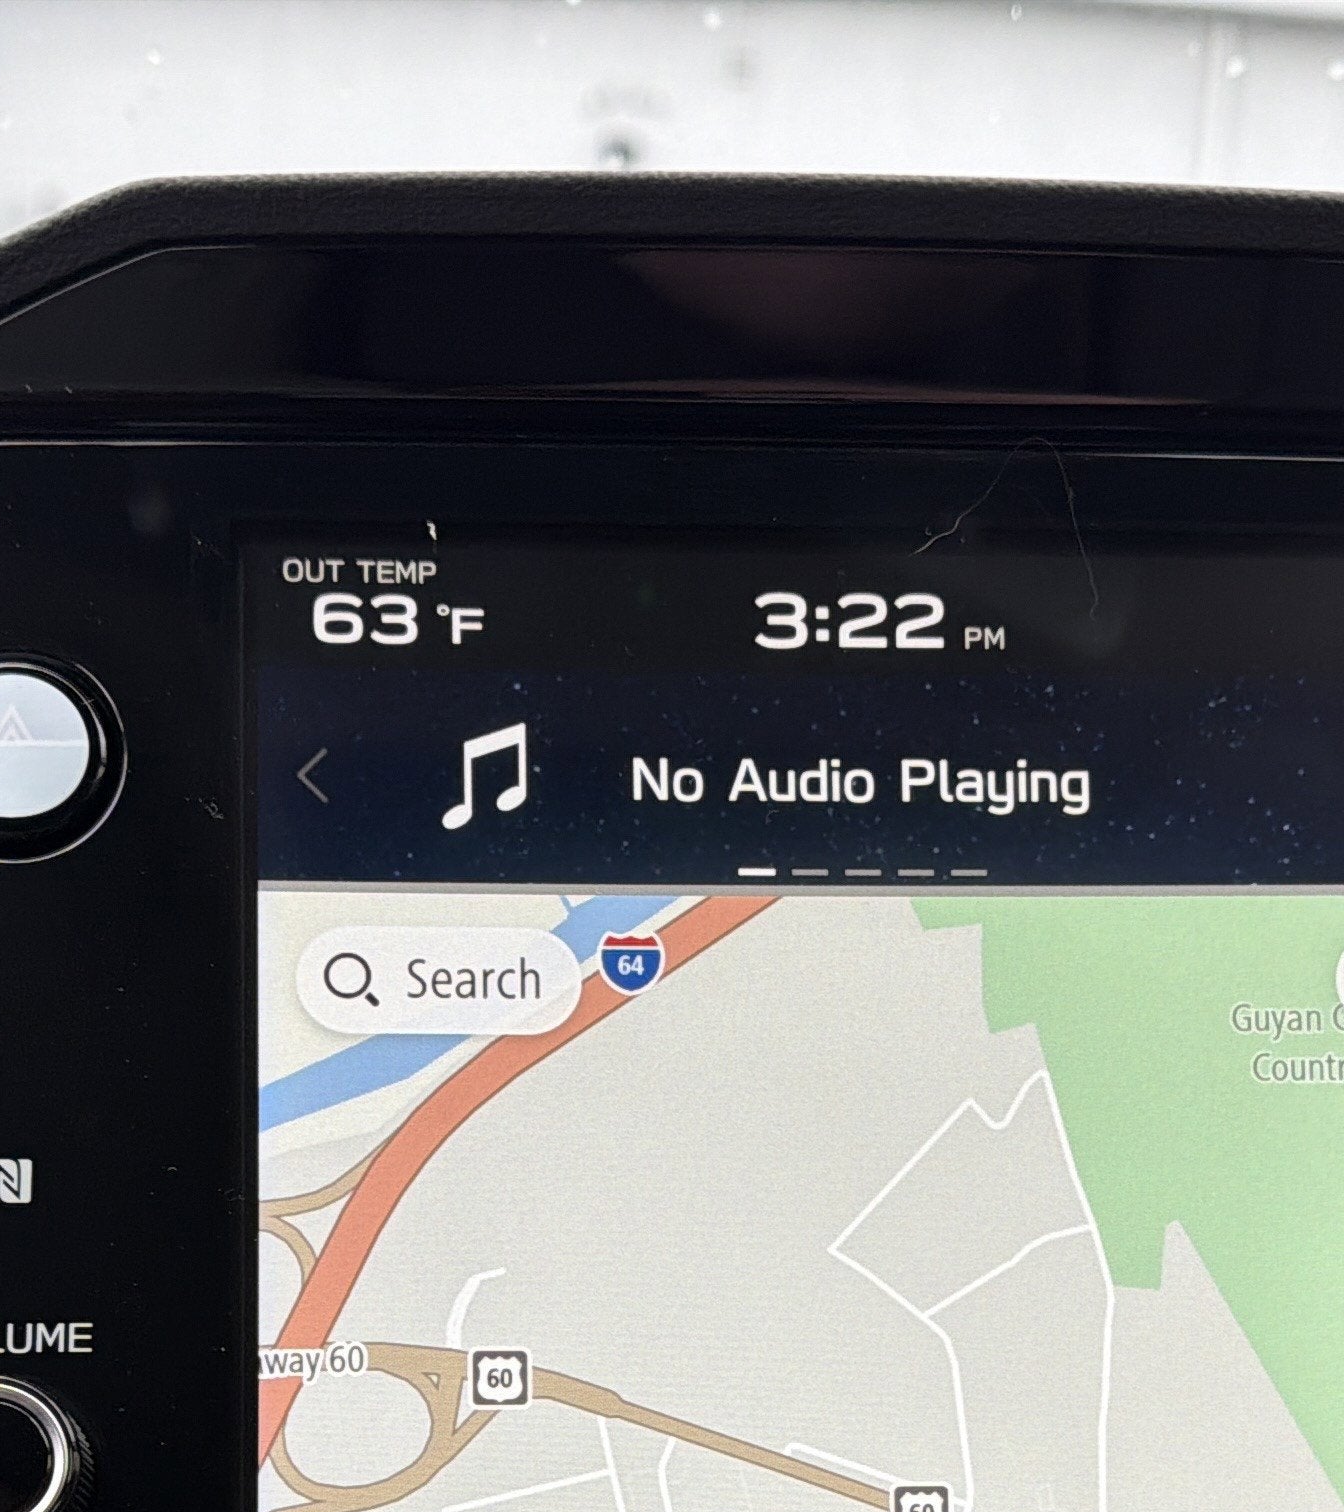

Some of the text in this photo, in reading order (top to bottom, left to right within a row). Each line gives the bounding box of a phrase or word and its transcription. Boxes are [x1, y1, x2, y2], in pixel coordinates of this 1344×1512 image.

[282, 558, 438, 585] OUT TEMP
[312, 592, 419, 645] 63
[754, 591, 1007, 650] 3:22 PM
[632, 757, 1090, 816] No Audio Playing
[407, 956, 541, 1000] Search
[617, 954, 645, 976] 64
[1231, 1003, 1322, 1041] Guyan
[258, 1344, 365, 1382] way 60
[486, 1367, 513, 1389] 60
